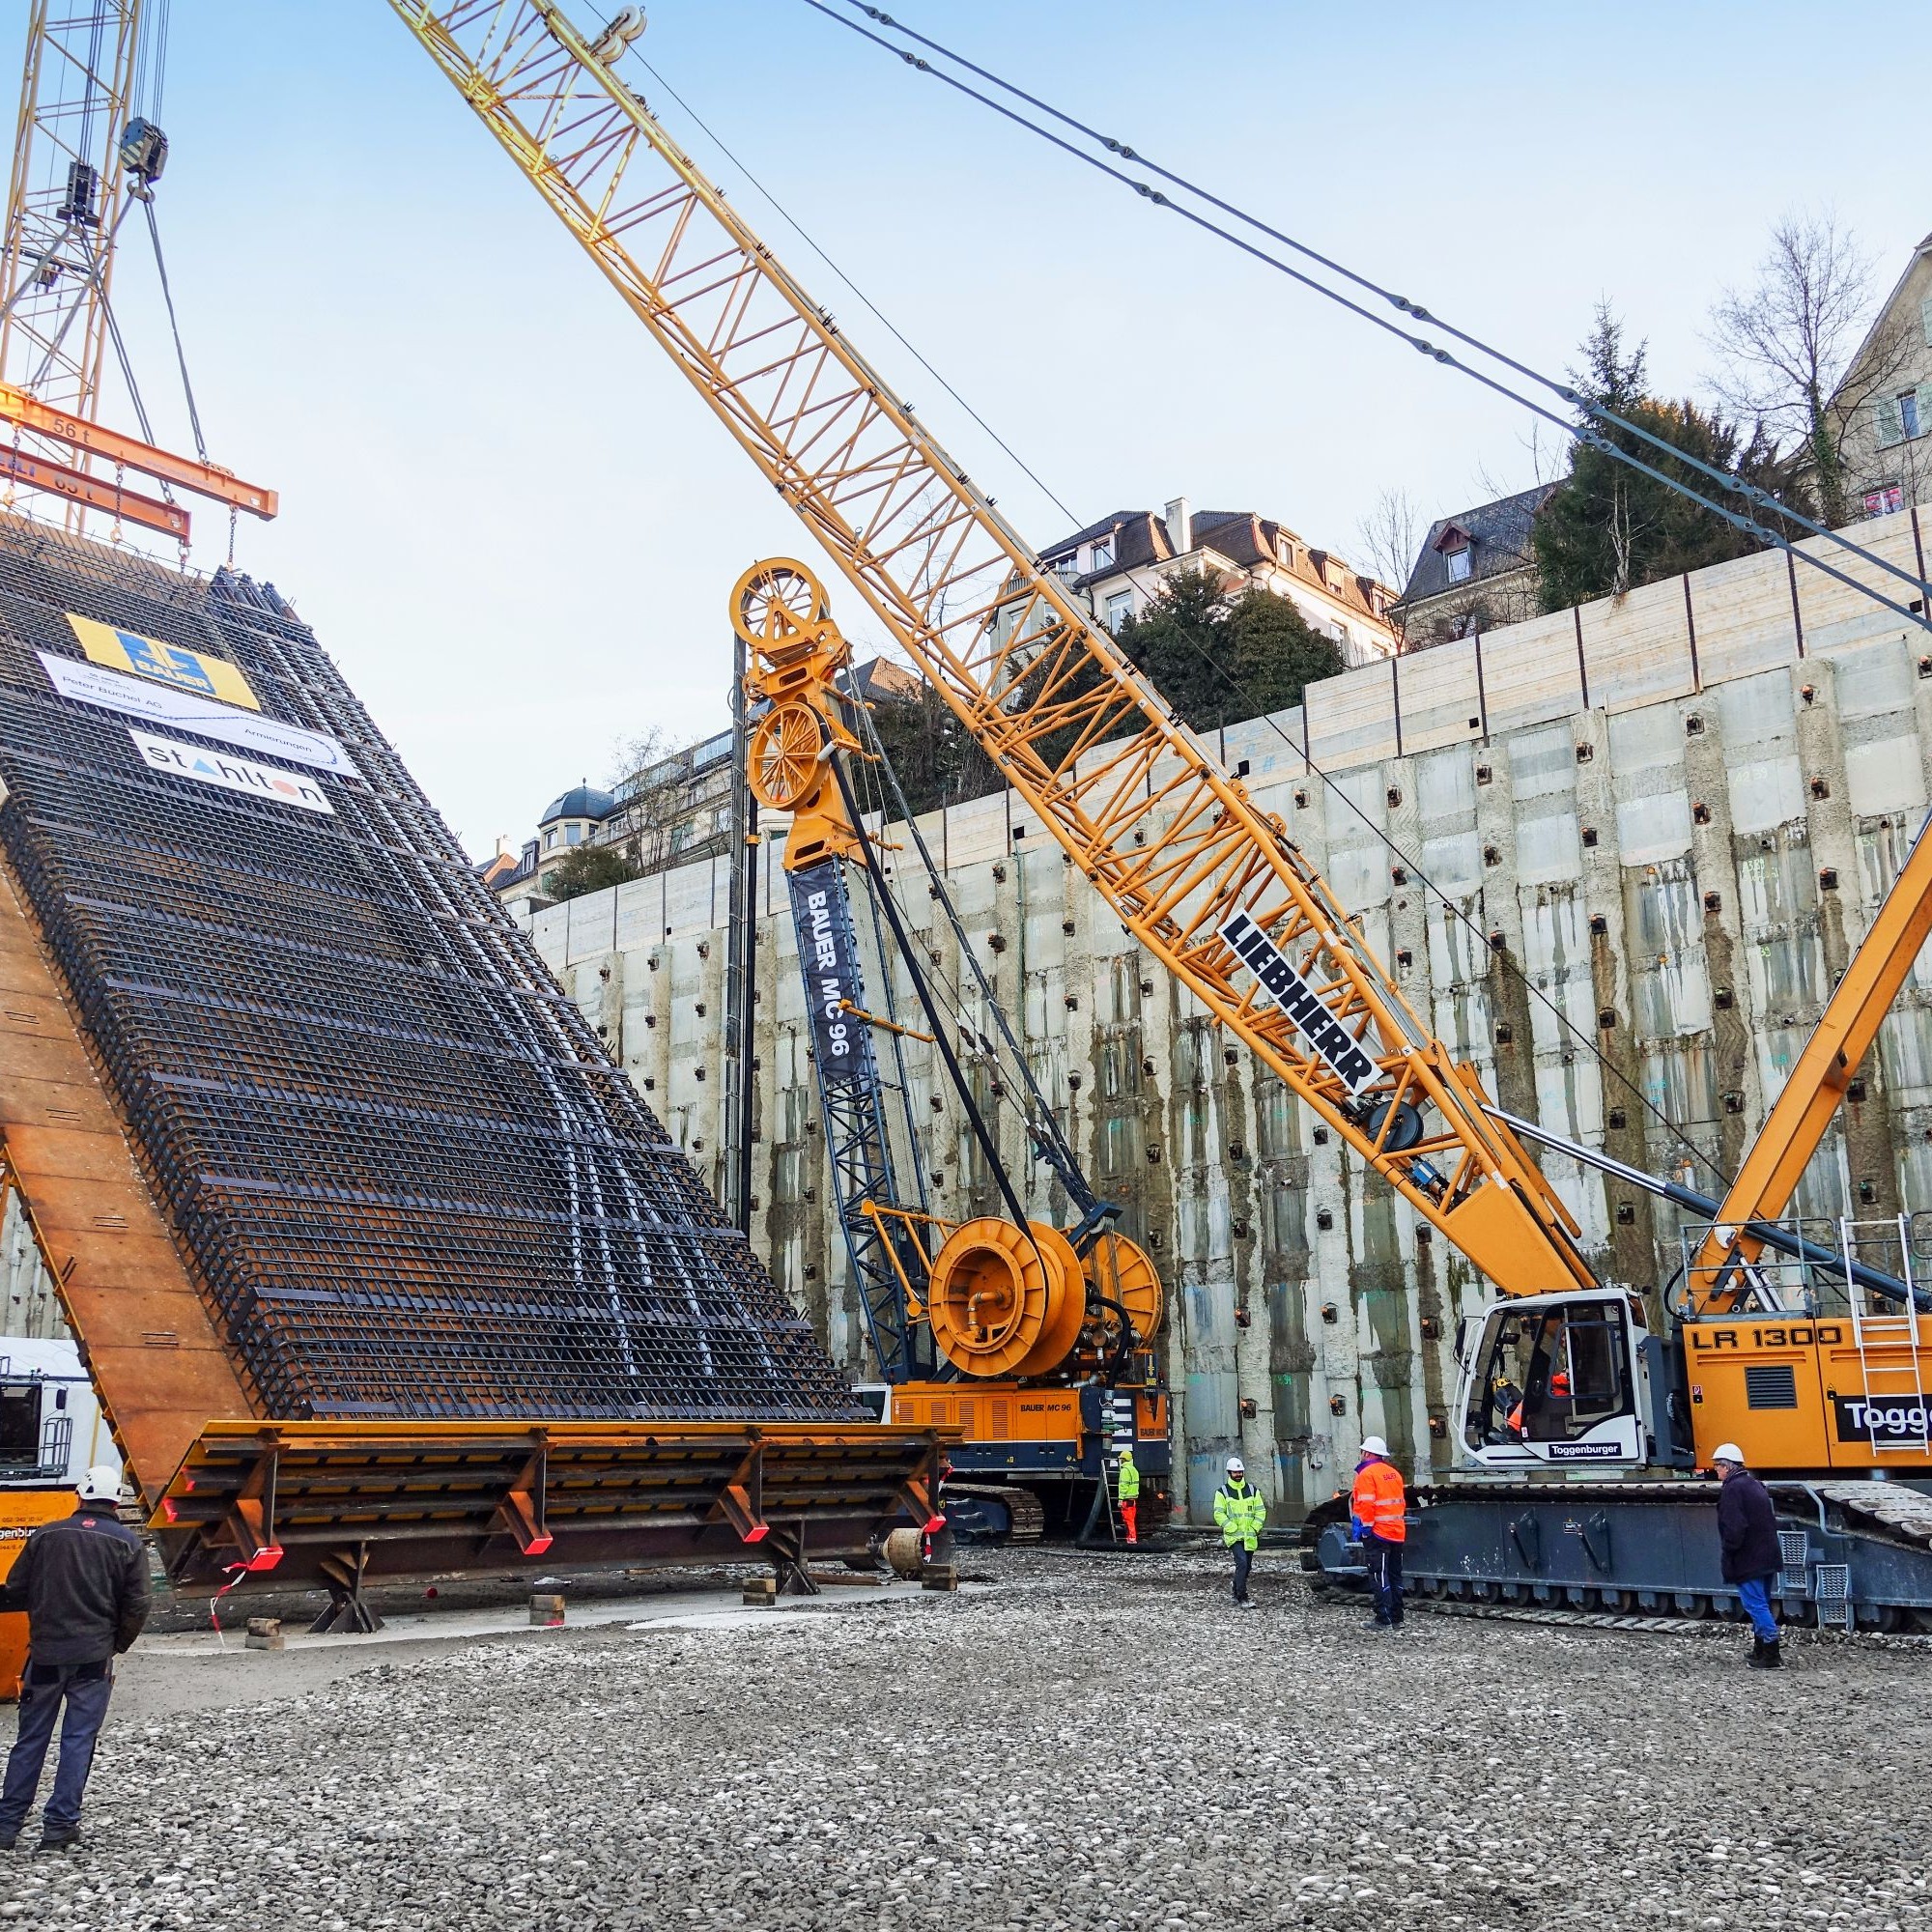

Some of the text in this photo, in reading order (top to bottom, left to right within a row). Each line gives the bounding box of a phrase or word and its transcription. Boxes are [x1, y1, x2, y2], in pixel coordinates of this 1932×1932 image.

[54, 417, 90, 444] 56 t
[135, 659, 211, 691] BAUER
[63, 676, 96, 691] Peter
[146, 700, 163, 710] AG
[244, 728, 312, 753] Armierungen
[808, 890, 850, 1057] BAUER MC 96
[1222, 913, 1373, 1090] LIEBHERR
[1691, 1325, 1844, 1350] LR 1300
[1844, 1403, 1932, 1435] Togg
[1551, 1444, 1619, 1456] Toggenburger
